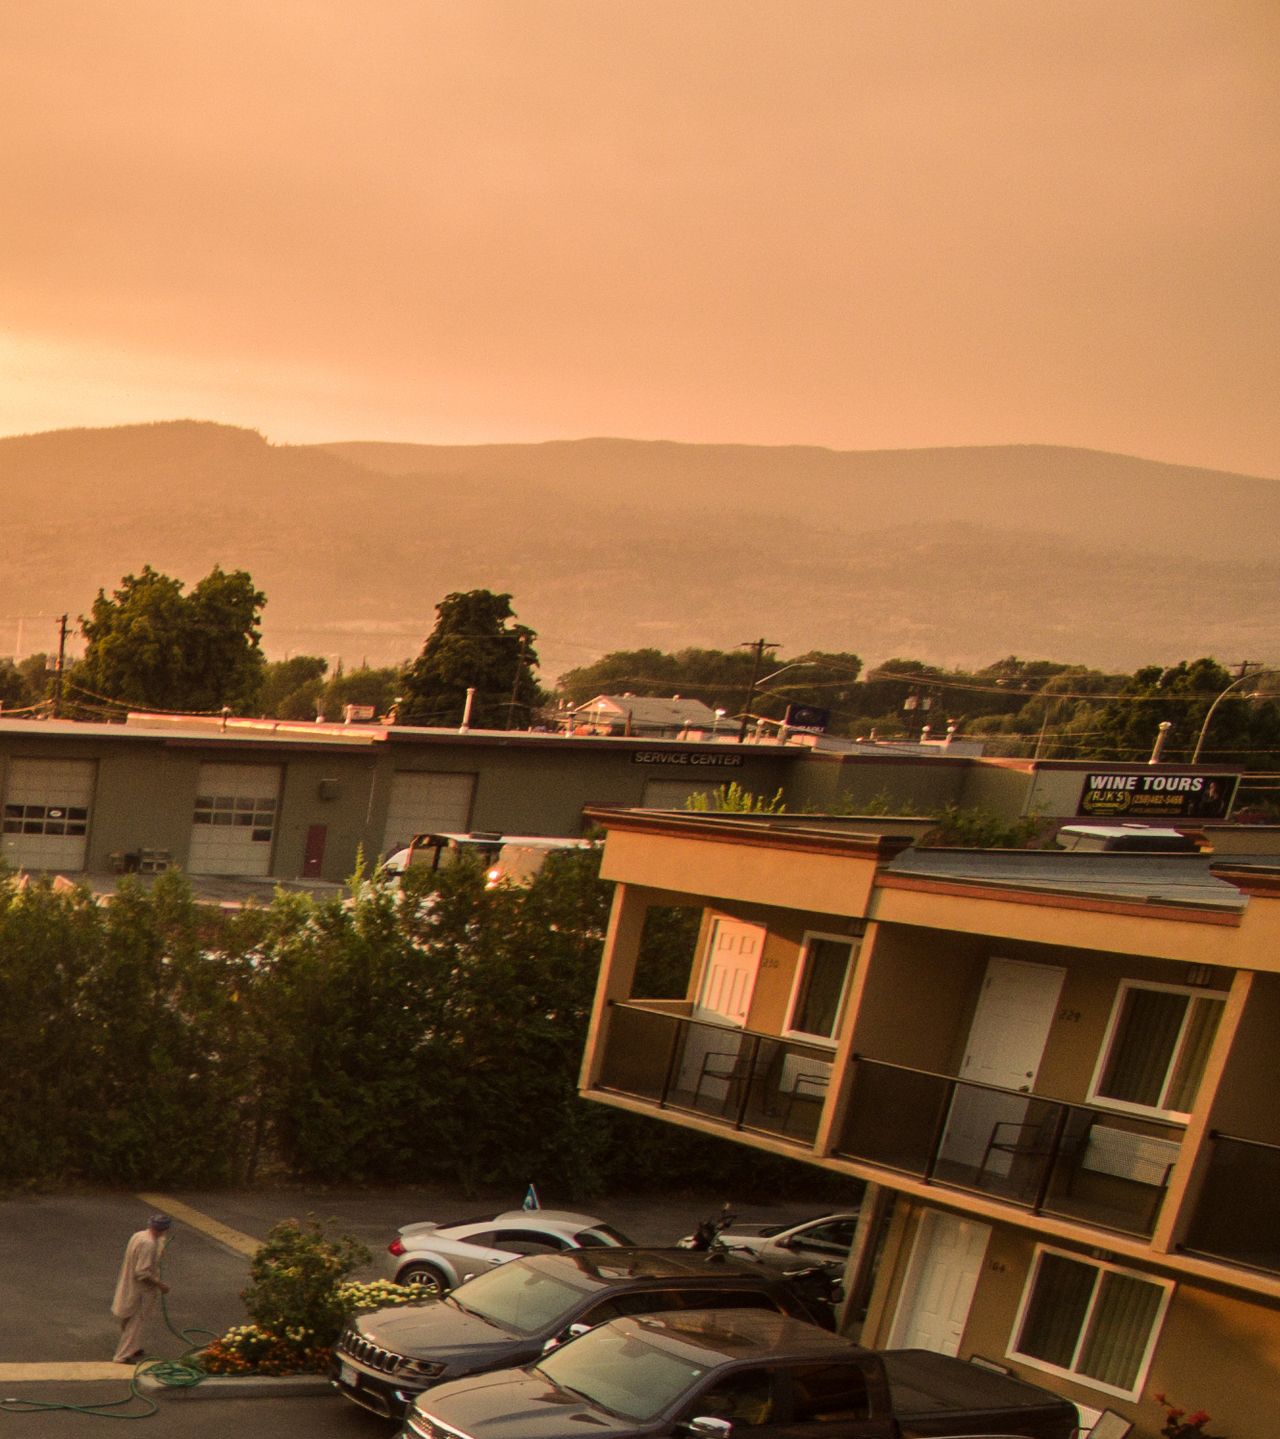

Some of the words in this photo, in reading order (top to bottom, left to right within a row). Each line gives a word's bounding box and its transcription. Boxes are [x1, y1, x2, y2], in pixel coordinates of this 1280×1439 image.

[635, 751, 688, 764] SERVICE
[690, 753, 741, 765] CENTER
[1090, 776, 1138, 790] WINE
[1143, 777, 1204, 791] TOURS
